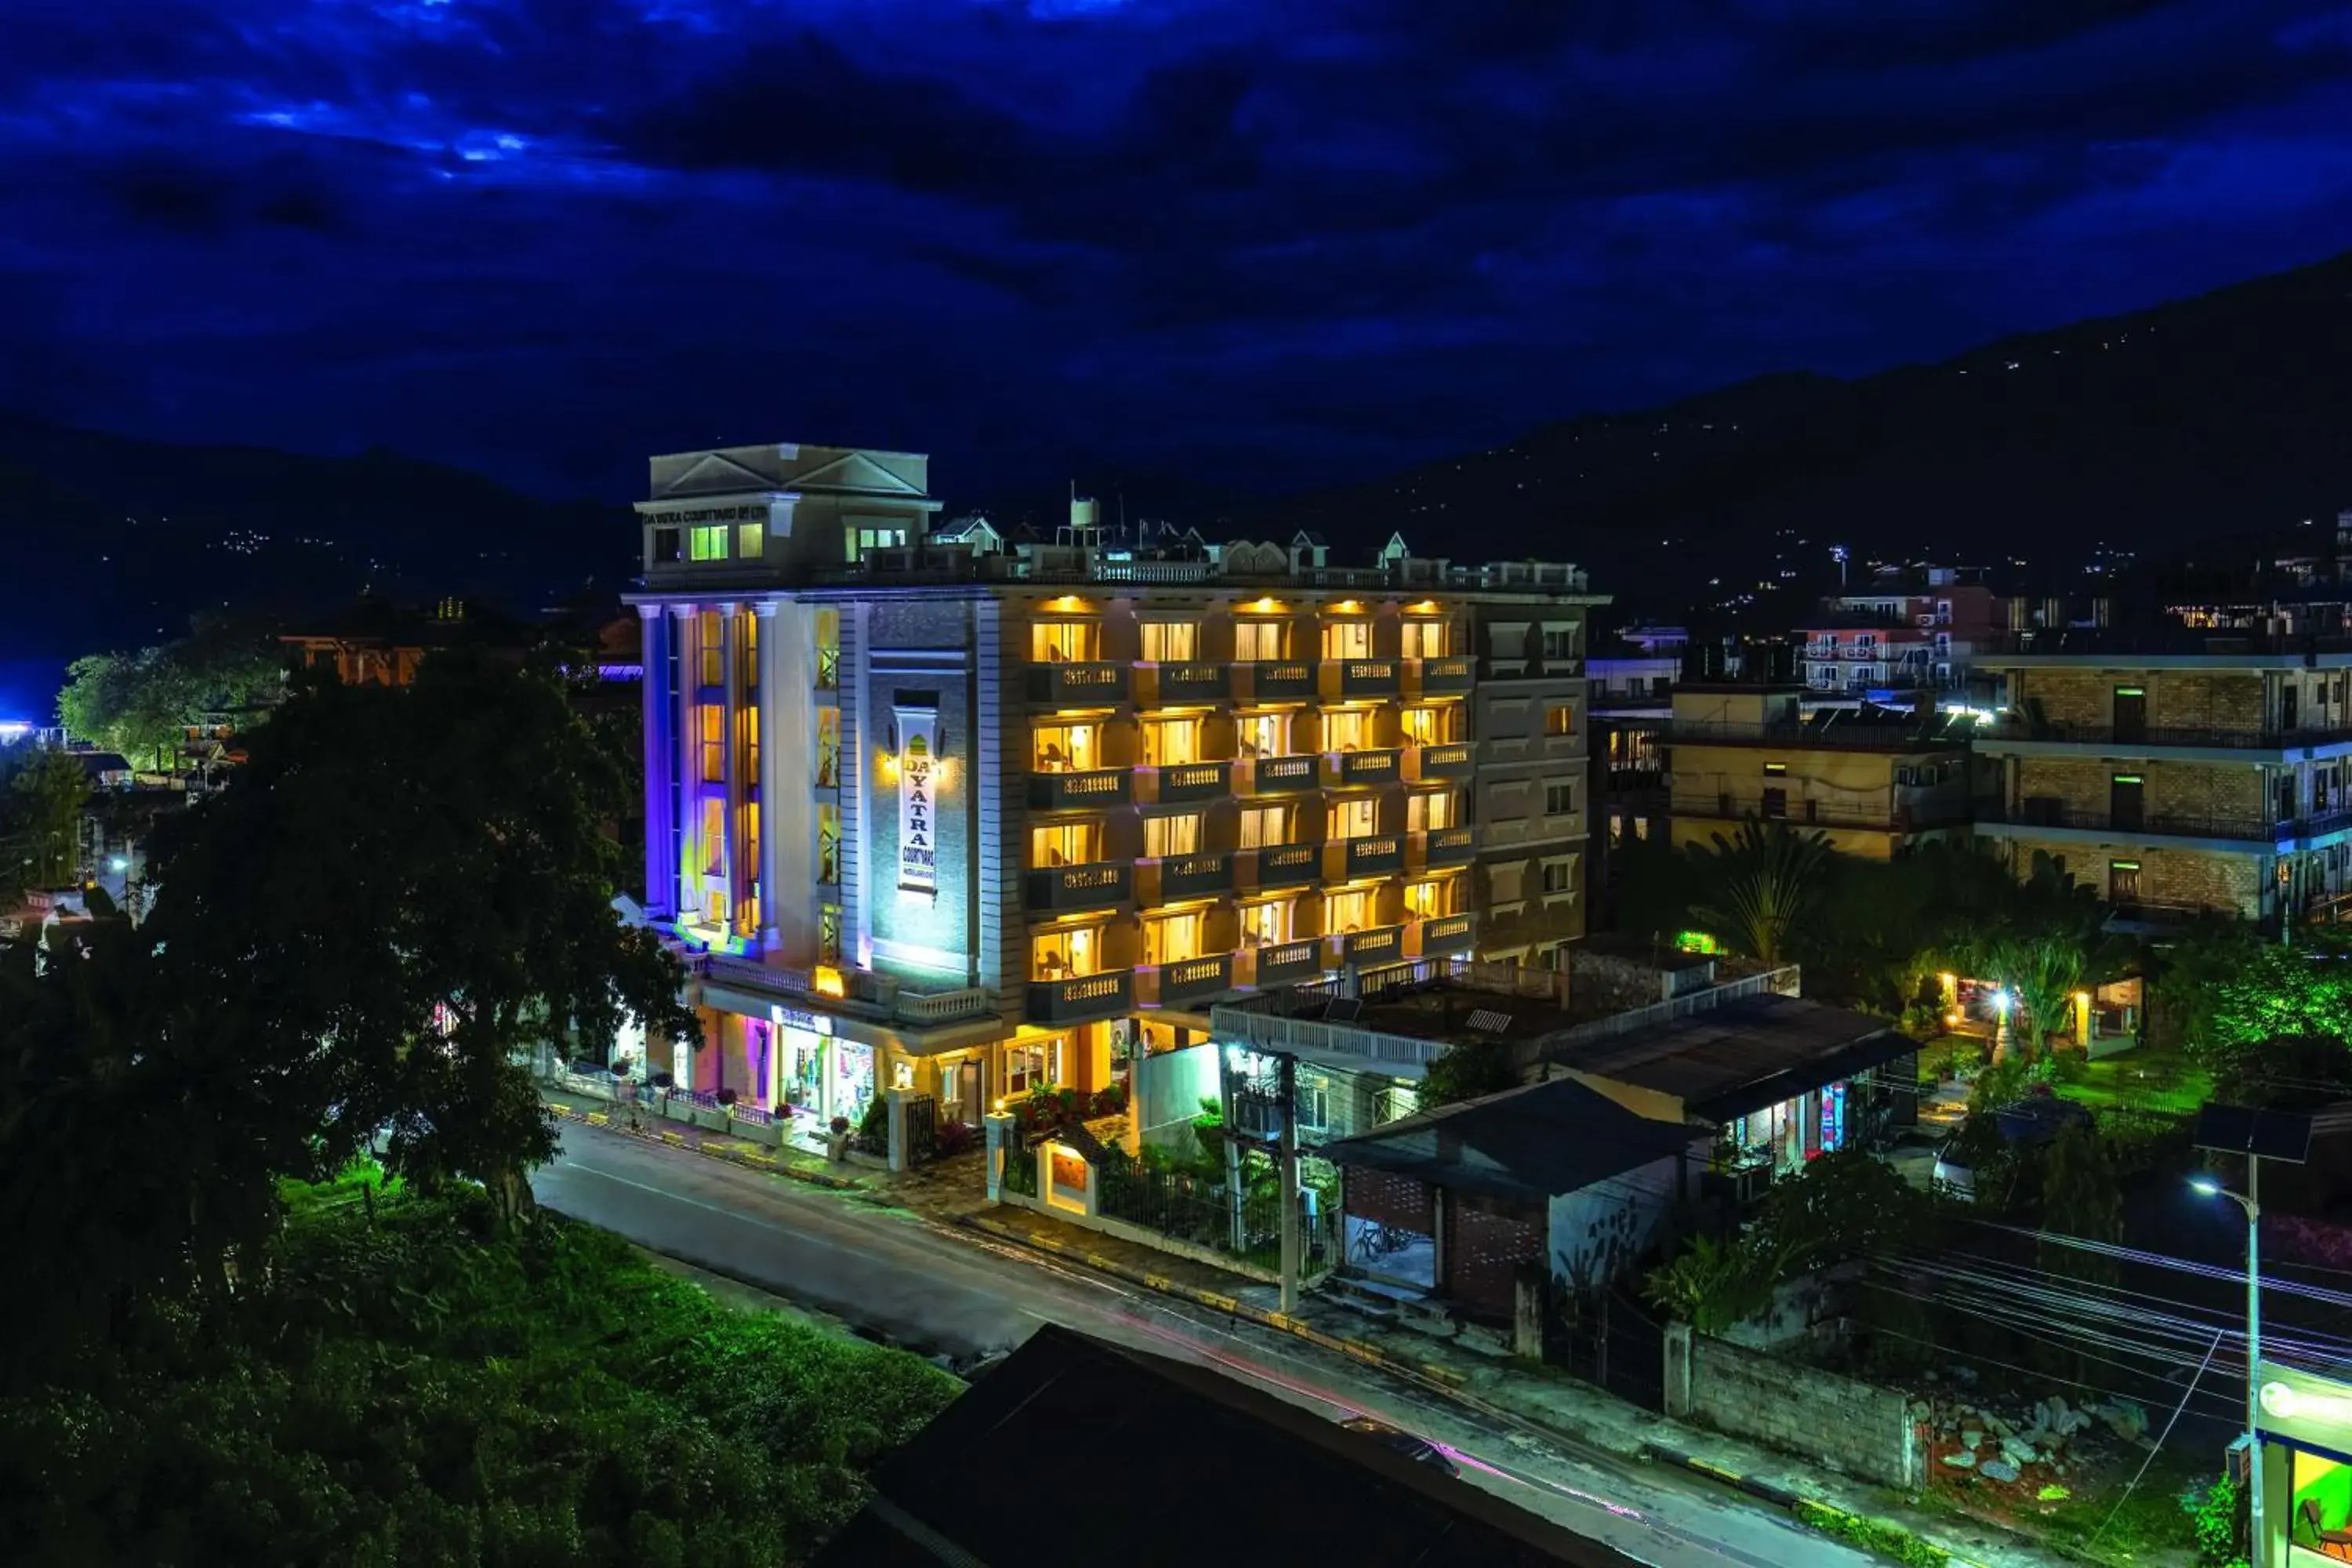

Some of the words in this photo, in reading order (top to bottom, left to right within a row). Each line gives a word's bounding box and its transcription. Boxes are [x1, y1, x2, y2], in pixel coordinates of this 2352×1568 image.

[655, 512, 682, 524] TRA
[683, 508, 736, 522] COUTYAD
[903, 760, 930, 772] DA
[909, 774, 927, 846] YATRA
[903, 845, 934, 866] COURD
